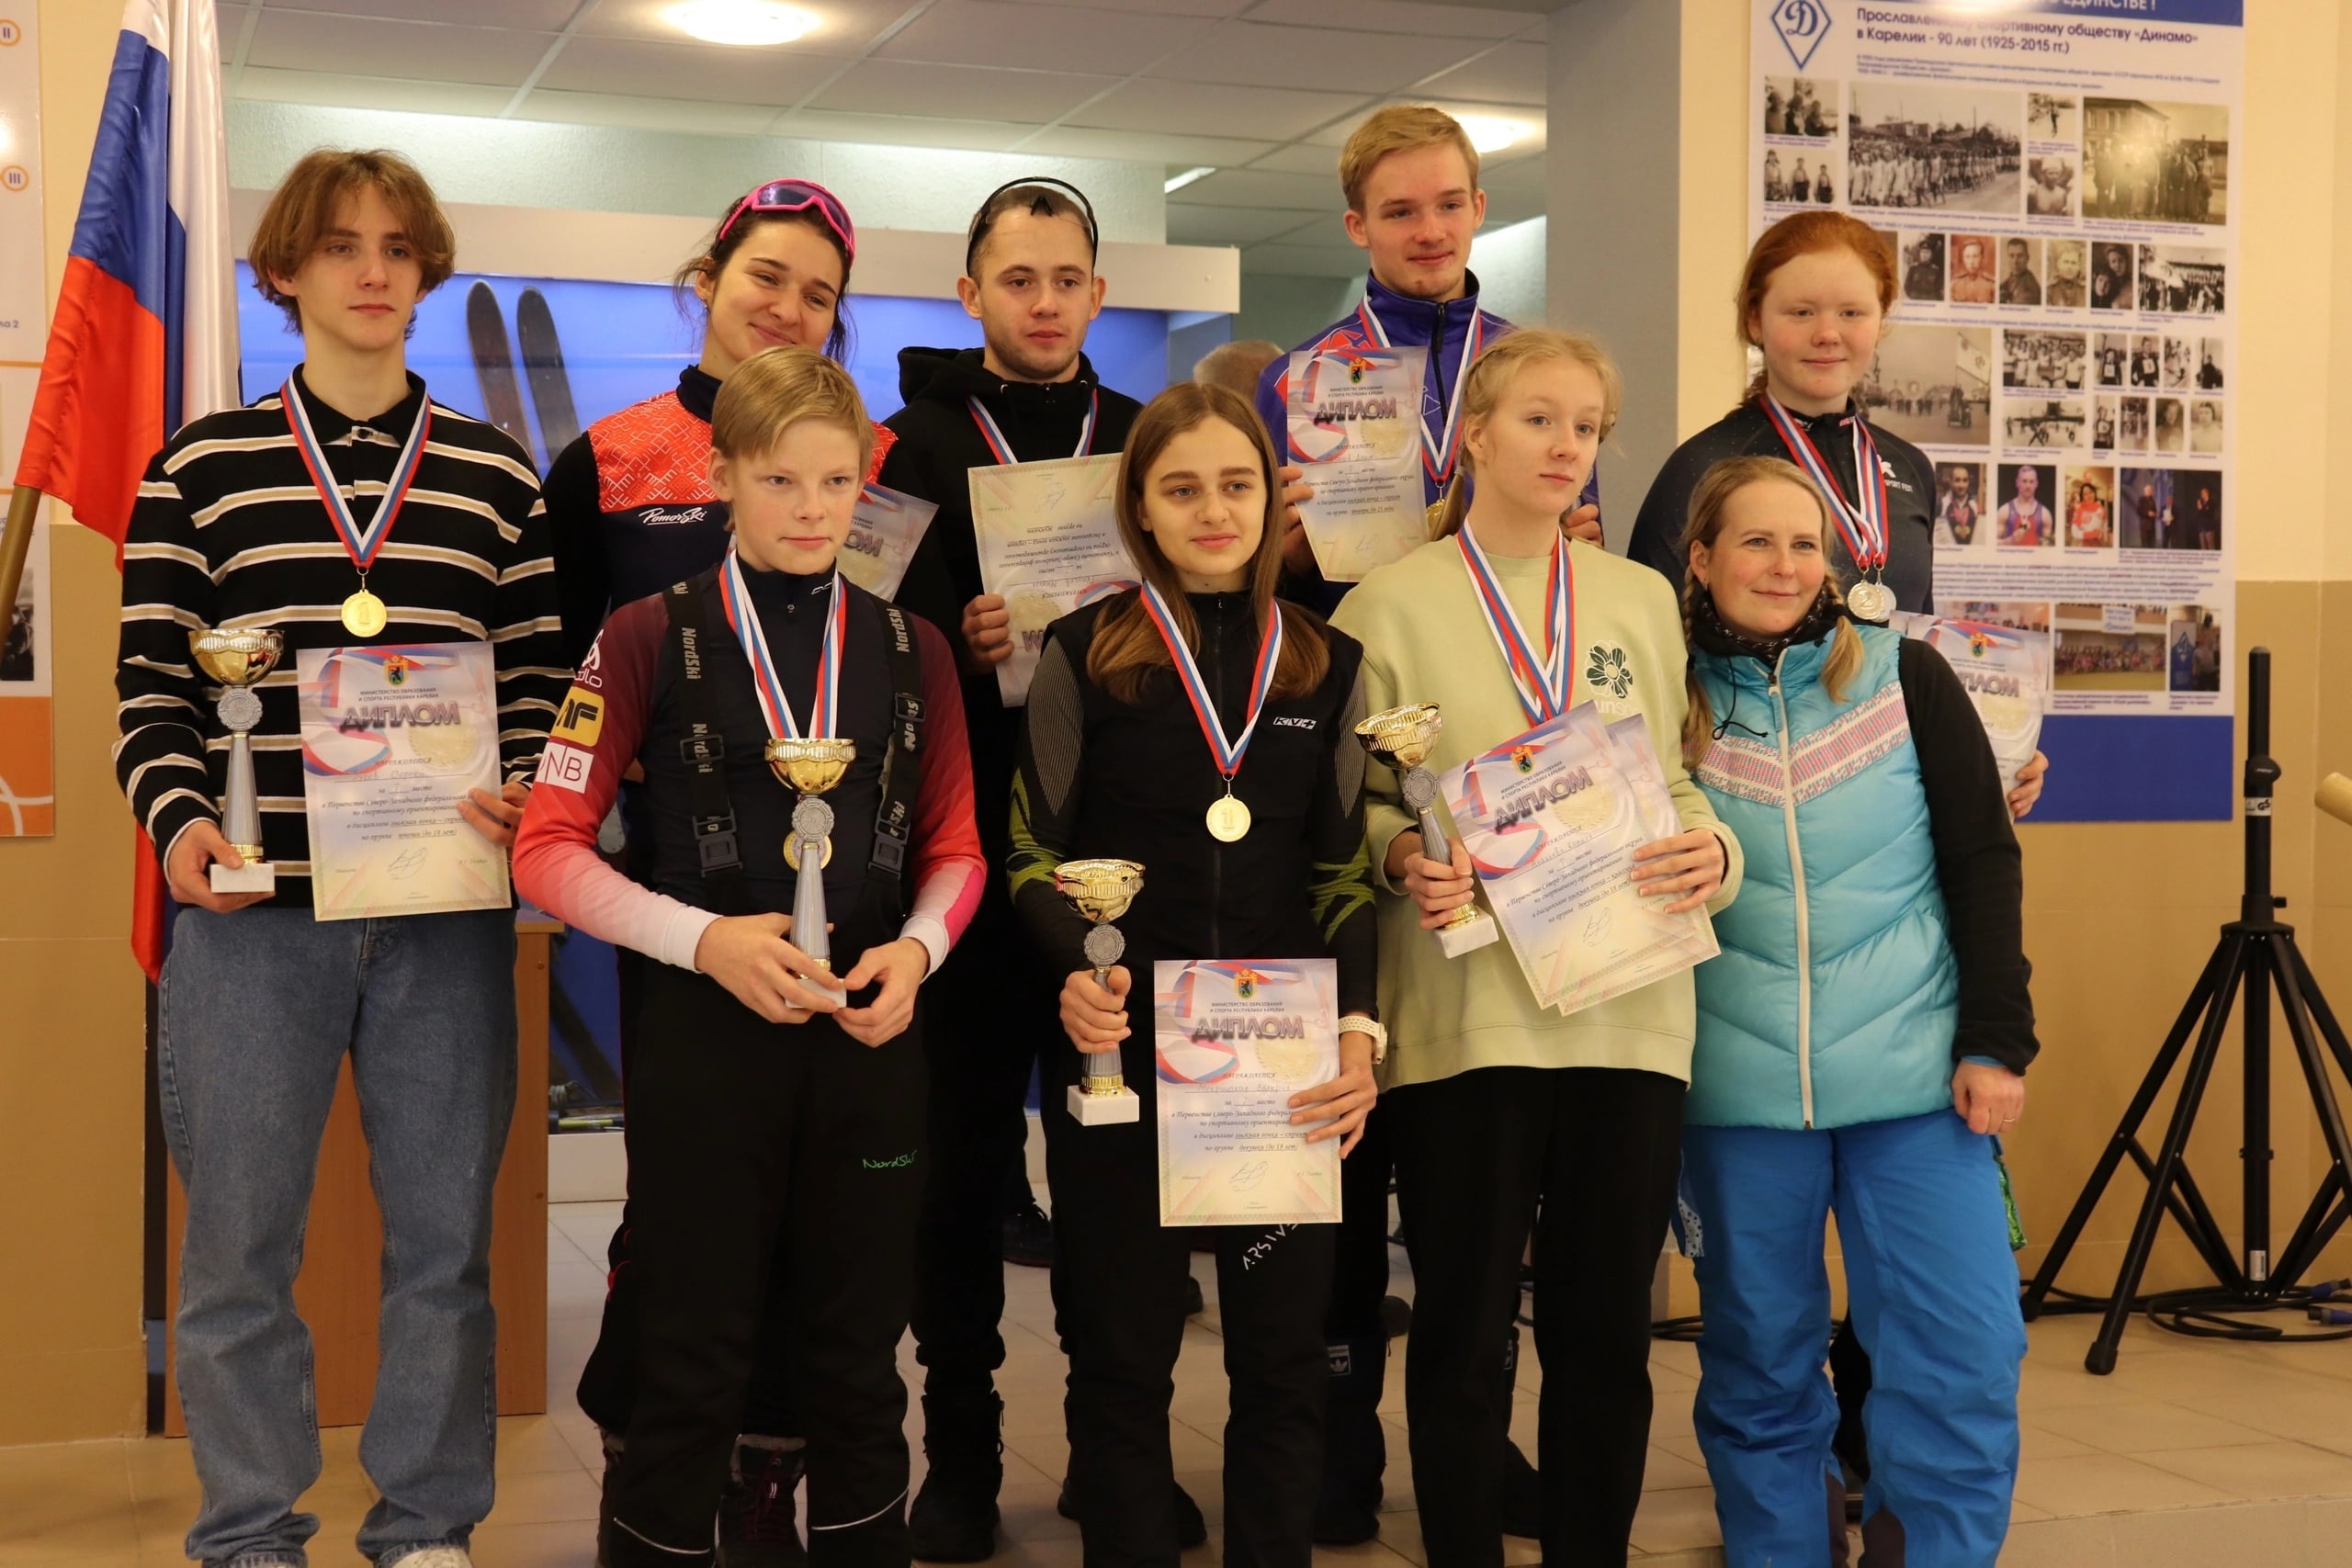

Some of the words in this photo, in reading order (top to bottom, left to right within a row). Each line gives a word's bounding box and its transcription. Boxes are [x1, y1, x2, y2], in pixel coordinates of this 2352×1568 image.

[1857, 29, 1863, 39] в
[1867, 28, 1926, 43] Карелии
[1938, 32, 1952, 45] 90
[1956, 37, 1977, 47] лет
[1981, 36, 2050, 51] (1925-2015
[1858, 8, 1972, 30] Прославлеу
[2067, 24, 2132, 40] обществу
[2134, 28, 2198, 43] «Динамо»
[1314, 398, 1396, 425] ДИПЛОМ
[1958, 671, 2019, 698] ПЛОМ
[340, 701, 461, 734] ДИПЛОМ
[539, 745, 582, 784] NB
[1495, 765, 1594, 835] ДИПЛОМ
[1192, 1015, 1306, 1043] ДИПЛОМ
[1267, 1109, 1294, 1117] федерал
[1242, 1223, 1299, 1271] ARSIV
